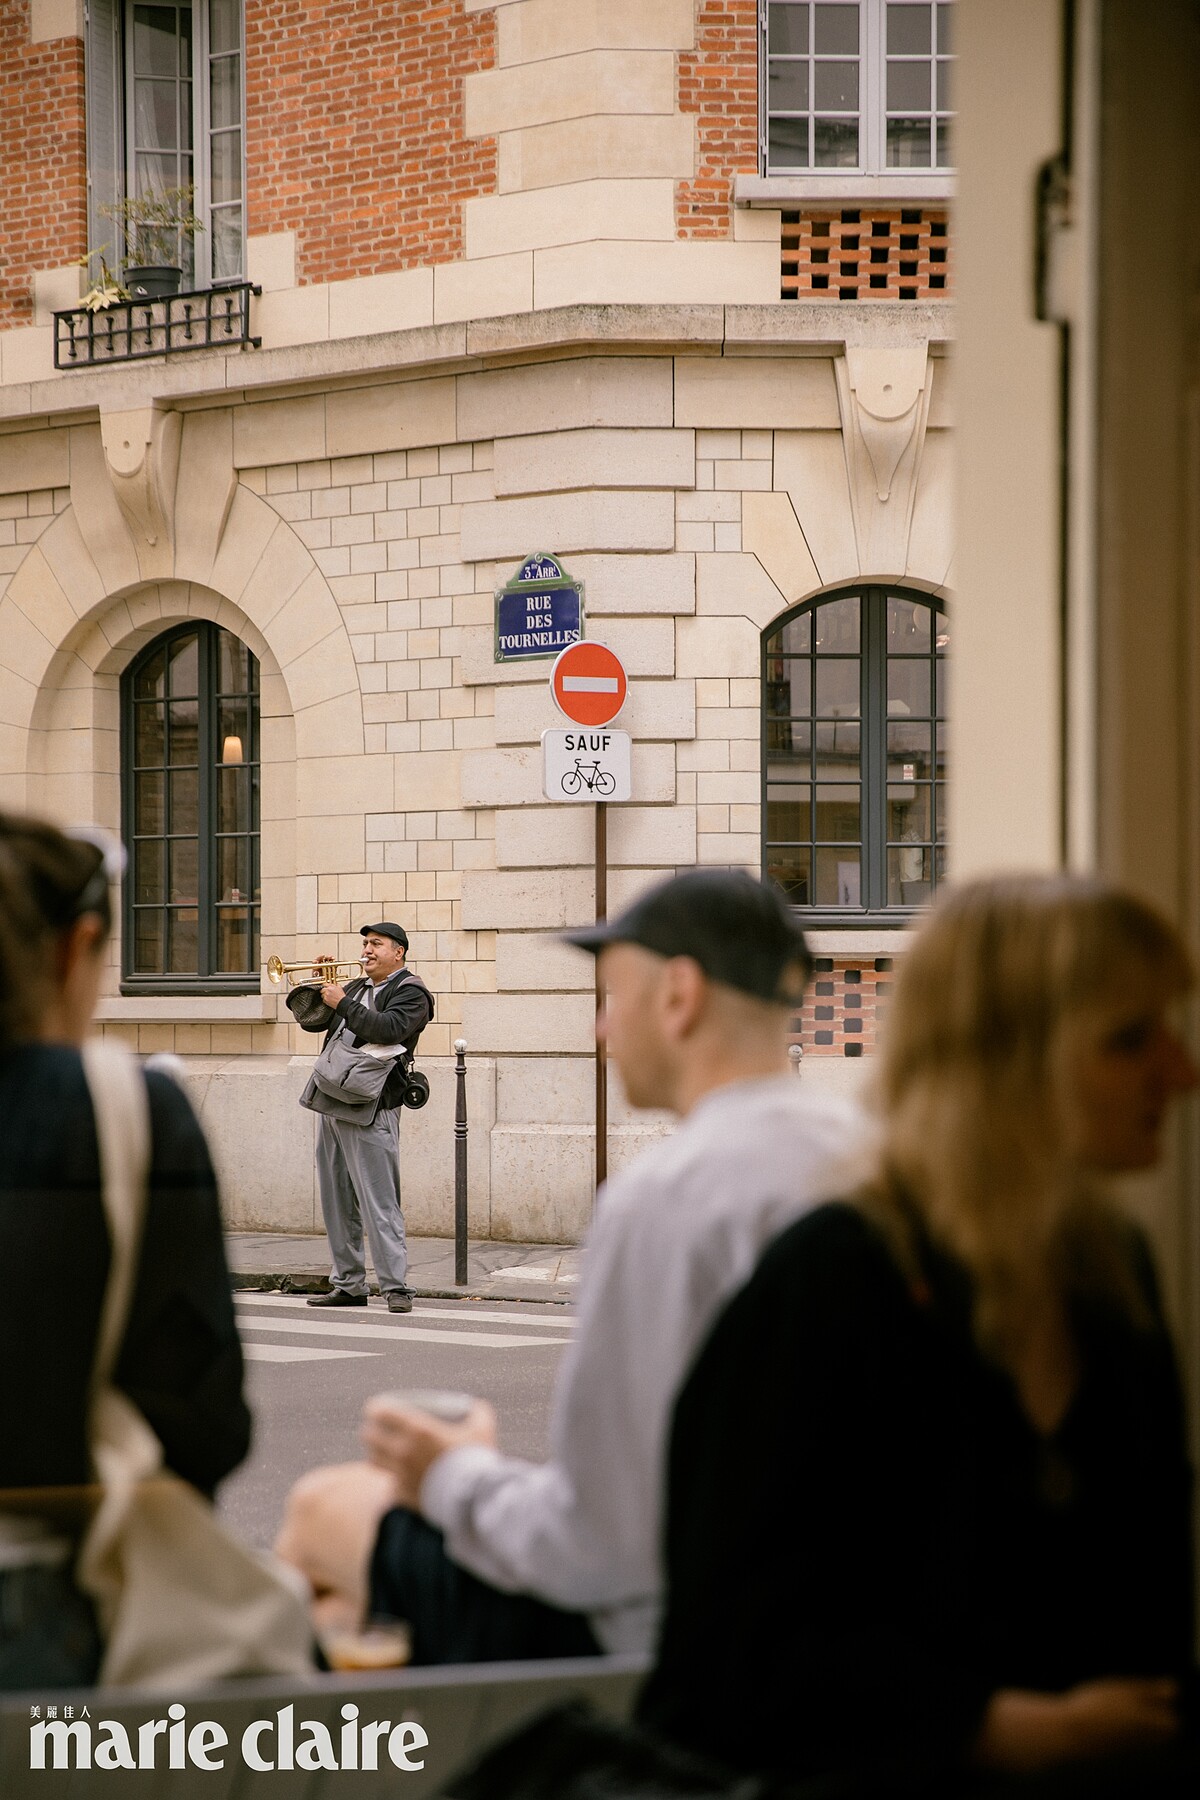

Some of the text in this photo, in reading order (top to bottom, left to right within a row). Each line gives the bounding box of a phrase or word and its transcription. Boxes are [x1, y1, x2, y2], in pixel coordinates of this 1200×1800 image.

[526, 595, 552, 612] RUE
[526, 613, 553, 630] DES
[499, 629, 580, 650] TOURNELLES
[565, 734, 611, 752] SAUF
